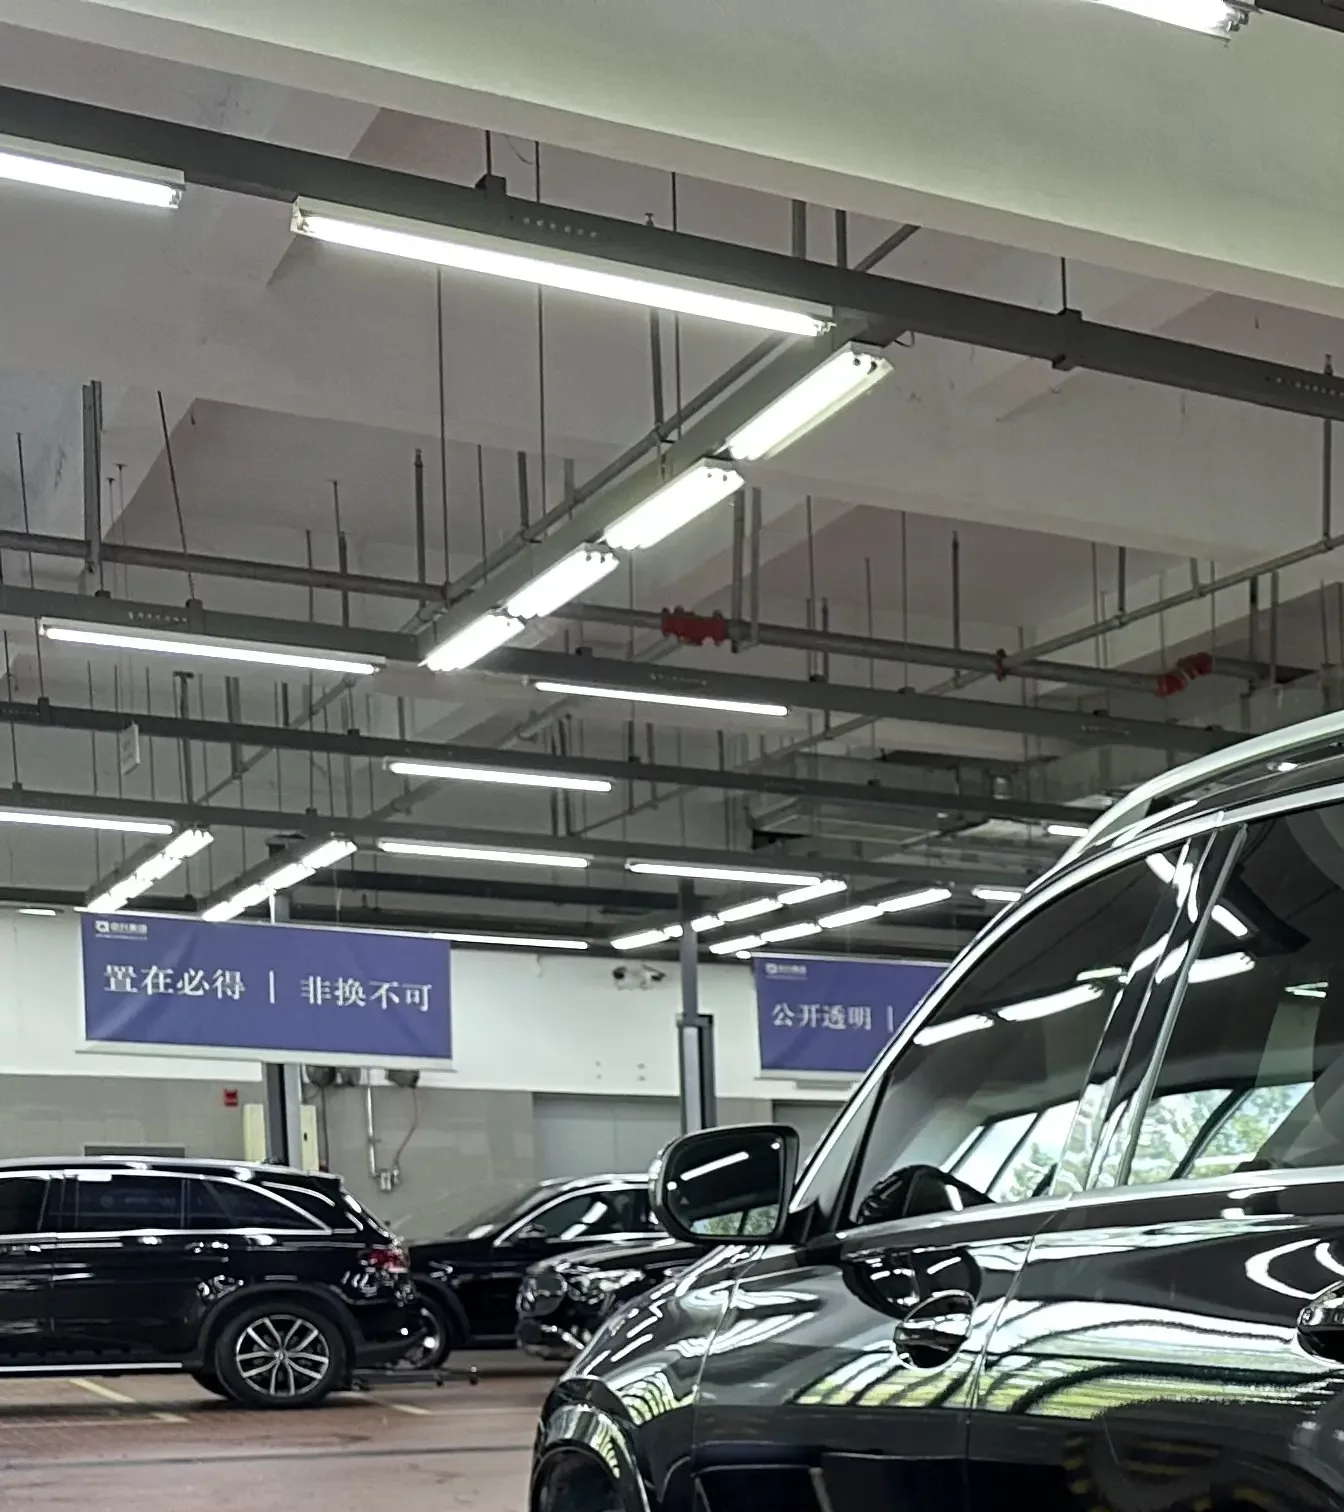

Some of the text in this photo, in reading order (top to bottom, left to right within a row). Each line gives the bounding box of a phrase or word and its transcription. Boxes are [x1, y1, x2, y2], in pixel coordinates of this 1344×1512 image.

[103, 964, 247, 1000] 置在必得
[299, 975, 434, 1012] 非换不可
[771, 1002, 872, 1031] 公开透明
